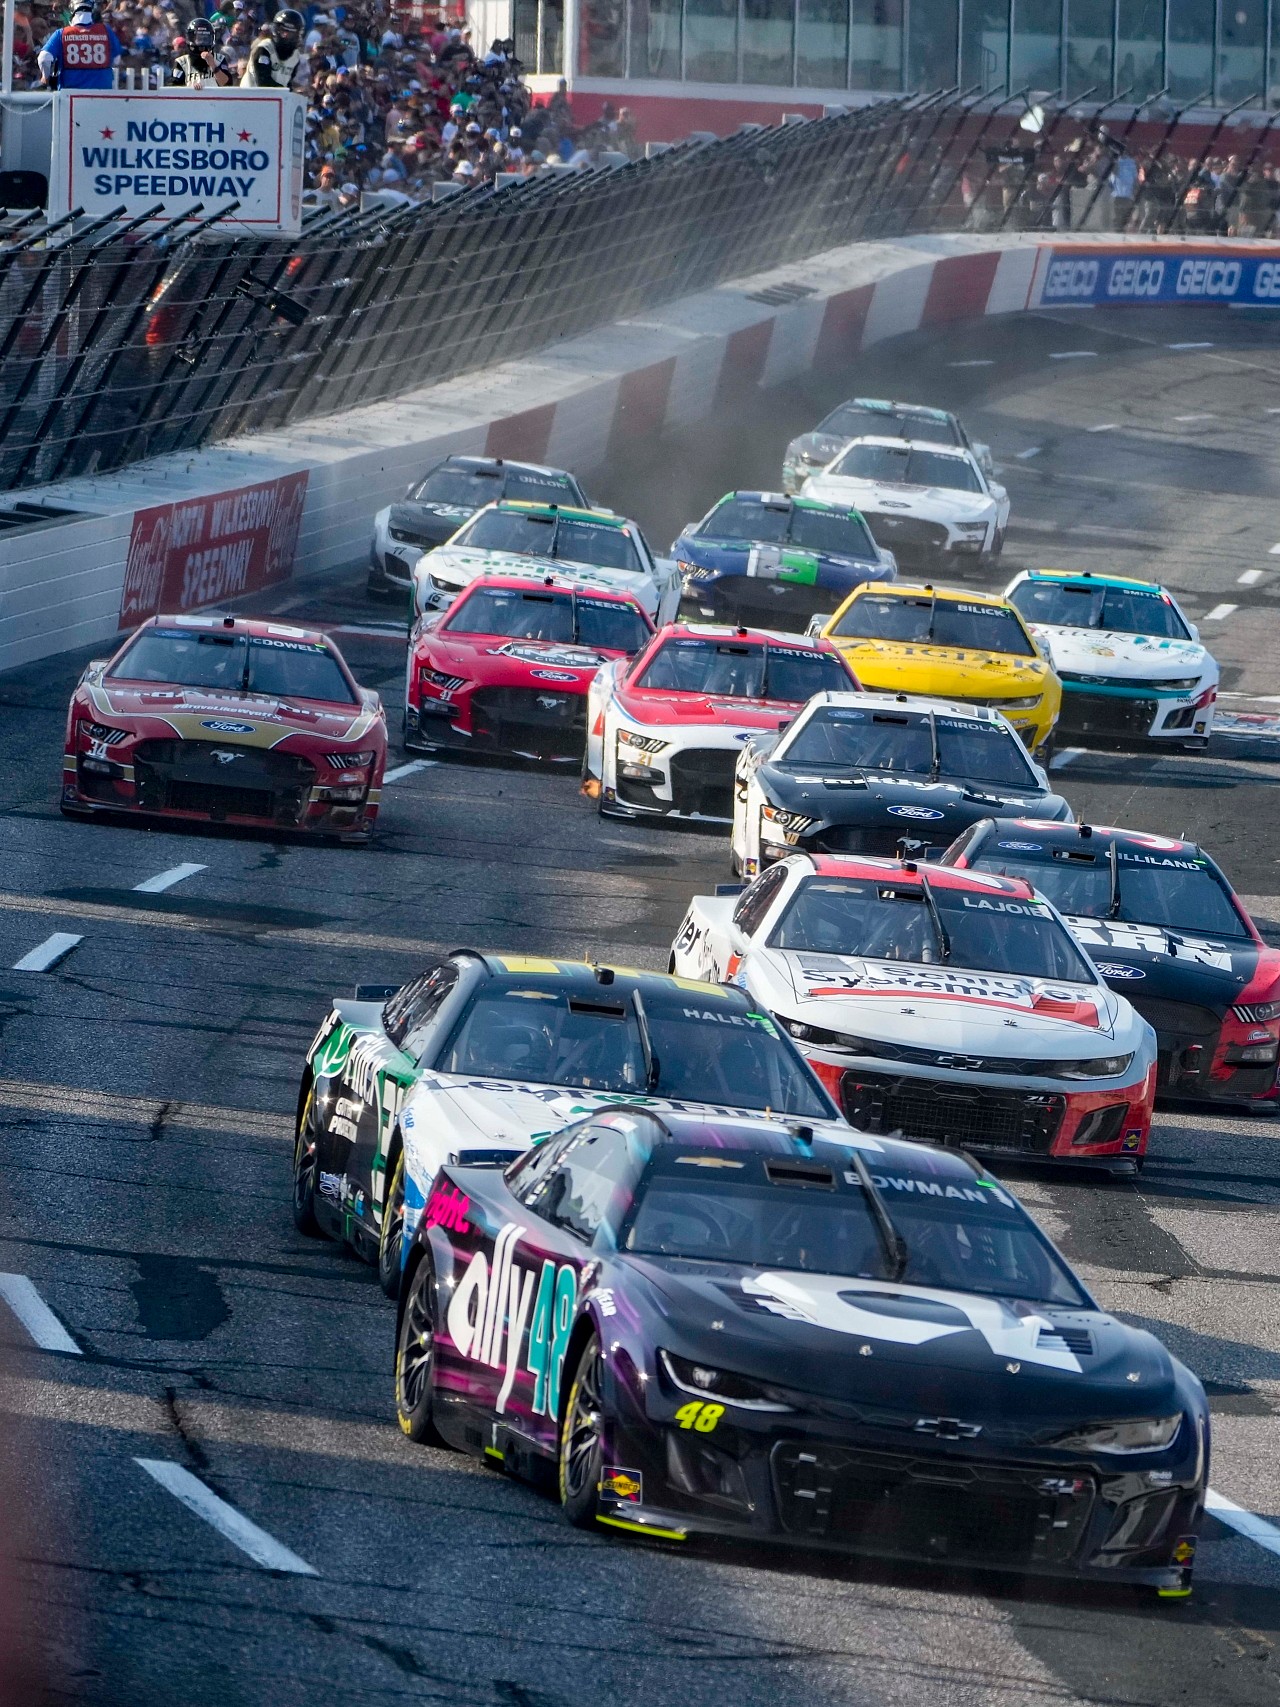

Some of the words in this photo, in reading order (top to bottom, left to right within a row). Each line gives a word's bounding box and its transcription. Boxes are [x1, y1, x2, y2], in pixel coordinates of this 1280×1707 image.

[66, 43, 106, 65] 838
[127, 121, 225, 143] NORTH
[82, 147, 269, 171] WILKESBORO
[94, 174, 256, 197] SPEEDWAY
[1046, 261, 1098, 297] GEICO
[1108, 261, 1165, 296] GEICO
[1176, 262, 1242, 297] GEICO
[181, 537, 255, 608] SPEEDWAY
[576, 598, 628, 612] PREECE
[1122, 589, 1161, 600] SMITH
[535, 655, 577, 666] CIRCLE
[534, 670, 574, 681] Ford
[206, 720, 250, 733] Ford
[88, 738, 108, 759] 34
[638, 751, 653, 766] 21
[893, 805, 939, 820] Ford
[1003, 841, 1038, 851] Ford
[1105, 850, 1200, 871] GILLILAND
[962, 897, 1044, 917] LAJOIE
[1072, 927, 1232, 972] ARN
[1096, 962, 1140, 979] Ford
[683, 1008, 757, 1029] HALEY
[843, 1169, 988, 1205] BOWMAN
[447, 1222, 538, 1414] ally
[527, 1258, 579, 1422] 48
[674, 1400, 726, 1433] 48
[604, 1480, 640, 1494] SUNOCO
